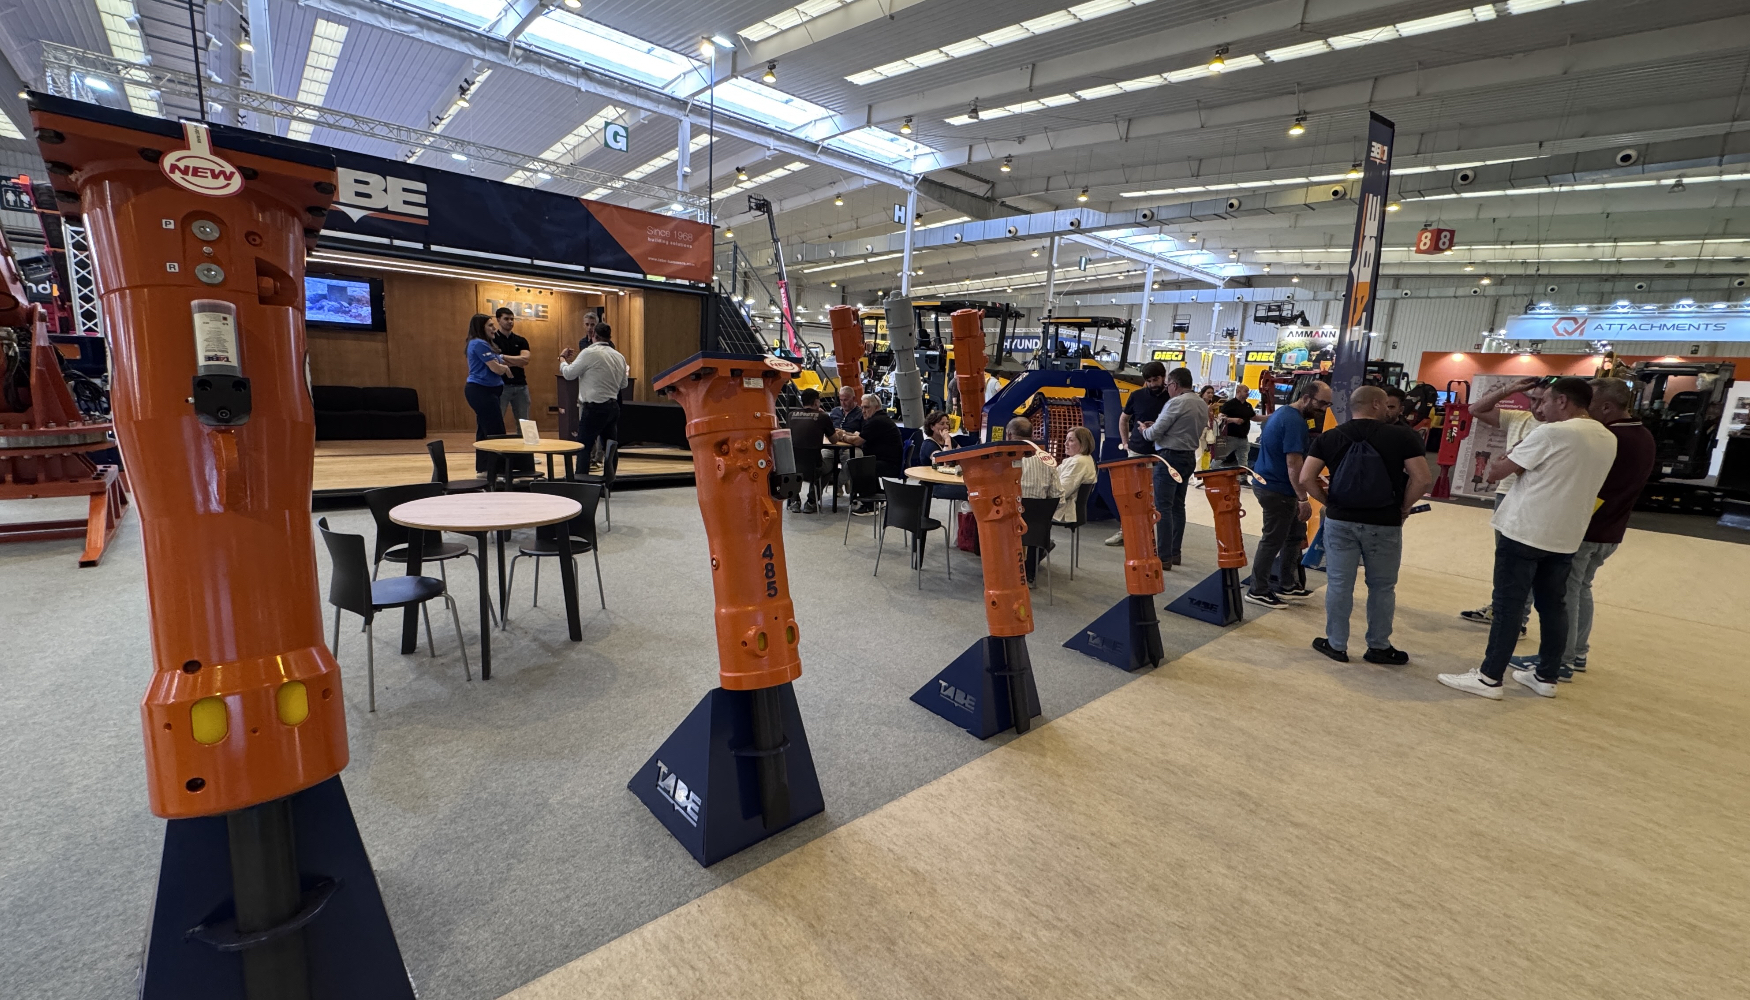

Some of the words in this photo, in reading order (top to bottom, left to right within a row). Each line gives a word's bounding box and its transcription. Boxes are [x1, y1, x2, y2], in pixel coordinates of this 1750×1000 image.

[605, 124, 627, 151] G
[169, 163, 236, 182] NEW
[336, 167, 429, 217] BE
[894, 204, 906, 224] H
[164, 220, 172, 228] P
[647, 226, 671, 238] Since
[673, 231, 694, 242] 1968
[1419, 231, 1433, 251] 8
[1438, 231, 1451, 250] 8
[168, 264, 177, 272] R
[1594, 323, 1727, 331] ATTACHMENTS
[1003, 338, 1051, 350] HYUNDI
[770, 360, 793, 369] NEW
[1246, 351, 1275, 361] DIEC
[1040, 455, 1052, 463] NEW
[762, 544, 778, 598] 485
[938, 679, 977, 712] TABE
[657, 759, 702, 823] TABE
